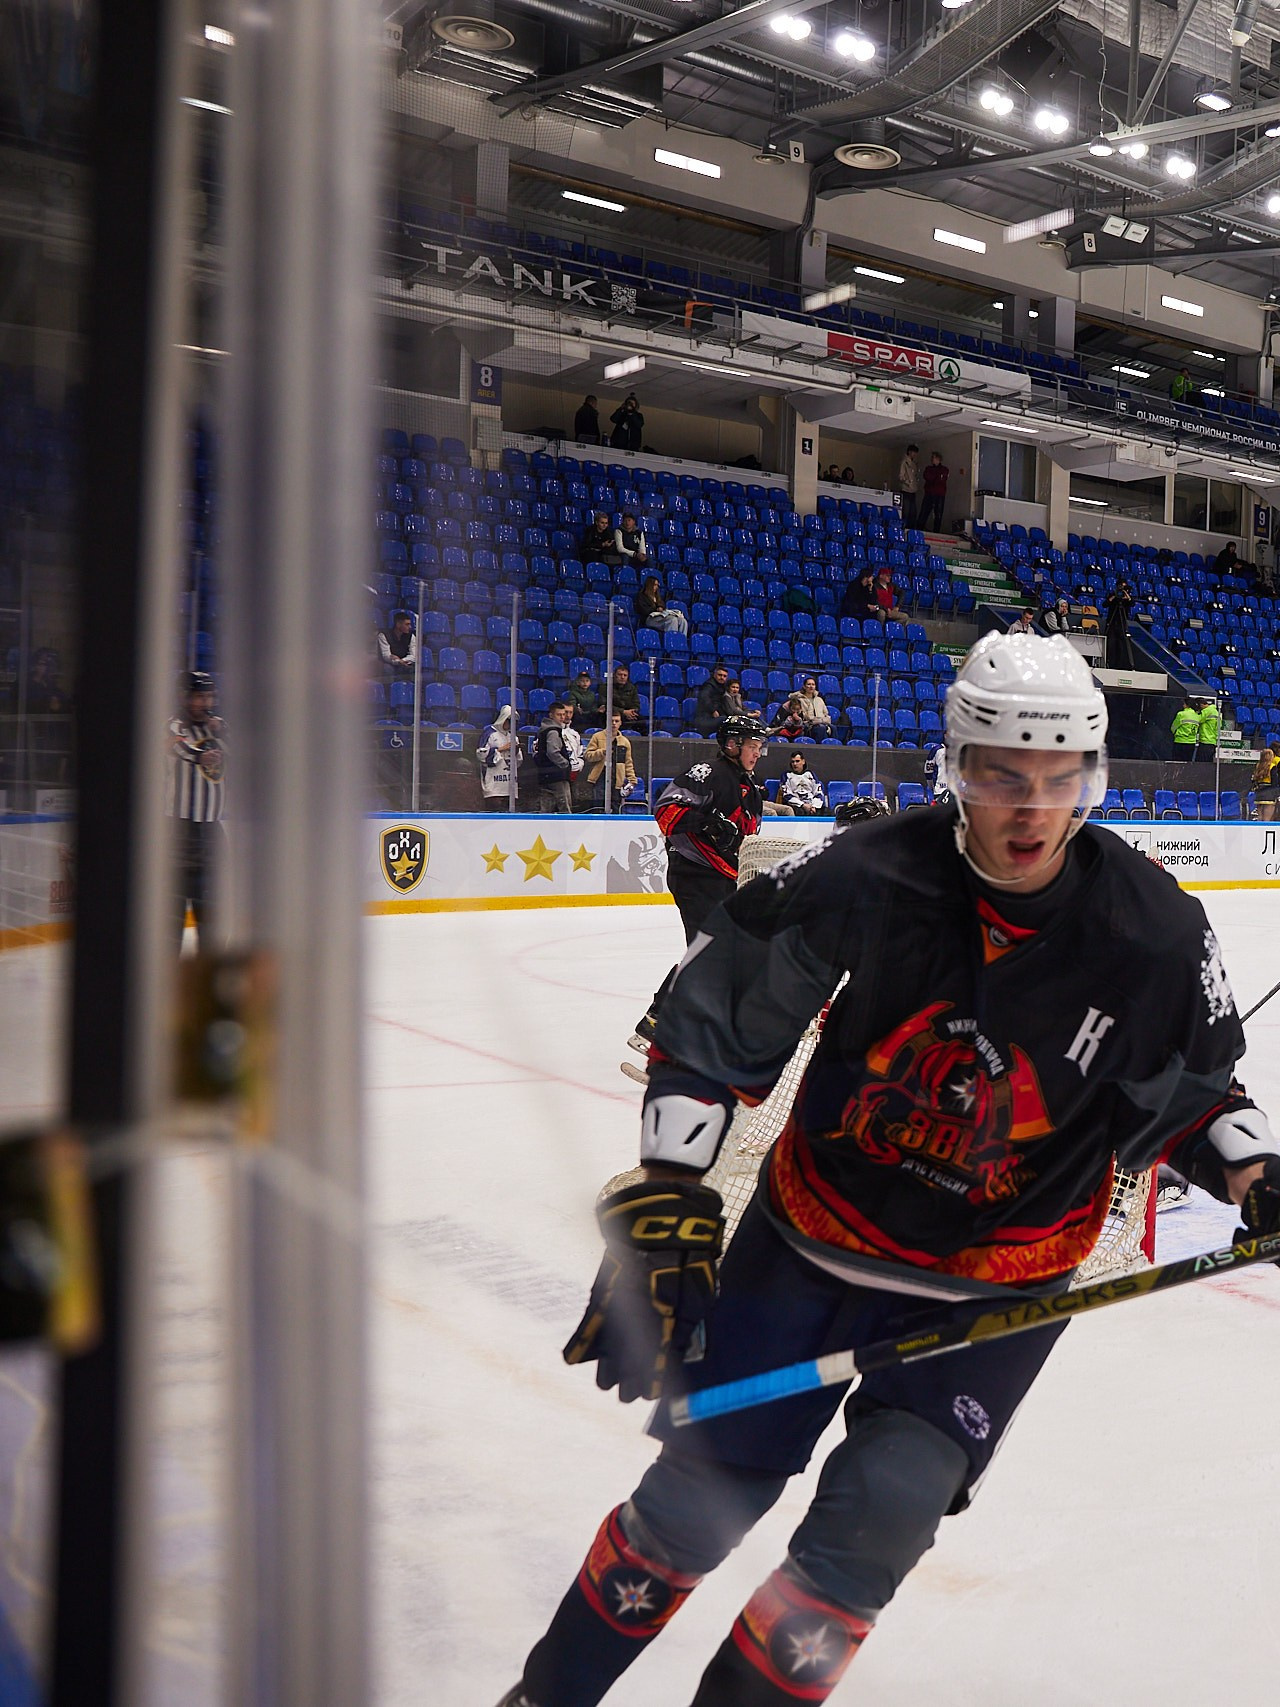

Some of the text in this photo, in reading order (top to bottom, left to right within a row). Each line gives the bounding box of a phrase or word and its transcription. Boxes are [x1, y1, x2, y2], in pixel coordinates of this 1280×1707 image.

[421, 242, 596, 306] TANK
[853, 342, 932, 374] SPAR
[480, 366, 493, 387] 8
[1181, 420, 1231, 442] ЧЕМПИОНАТ
[1232, 433, 1264, 449] РОССИИ
[1265, 441, 1277, 452] ПО
[1259, 511, 1265, 526] 9
[1017, 710, 1071, 720] BAUER
[1156, 839, 1200, 852] НИЖНИЙ
[1157, 855, 1209, 867] НОВГОРОД
[928, 1168, 970, 1196] РОССИИ
[631, 1216, 718, 1242] CC
[992, 1278, 1138, 1328] TACKS
